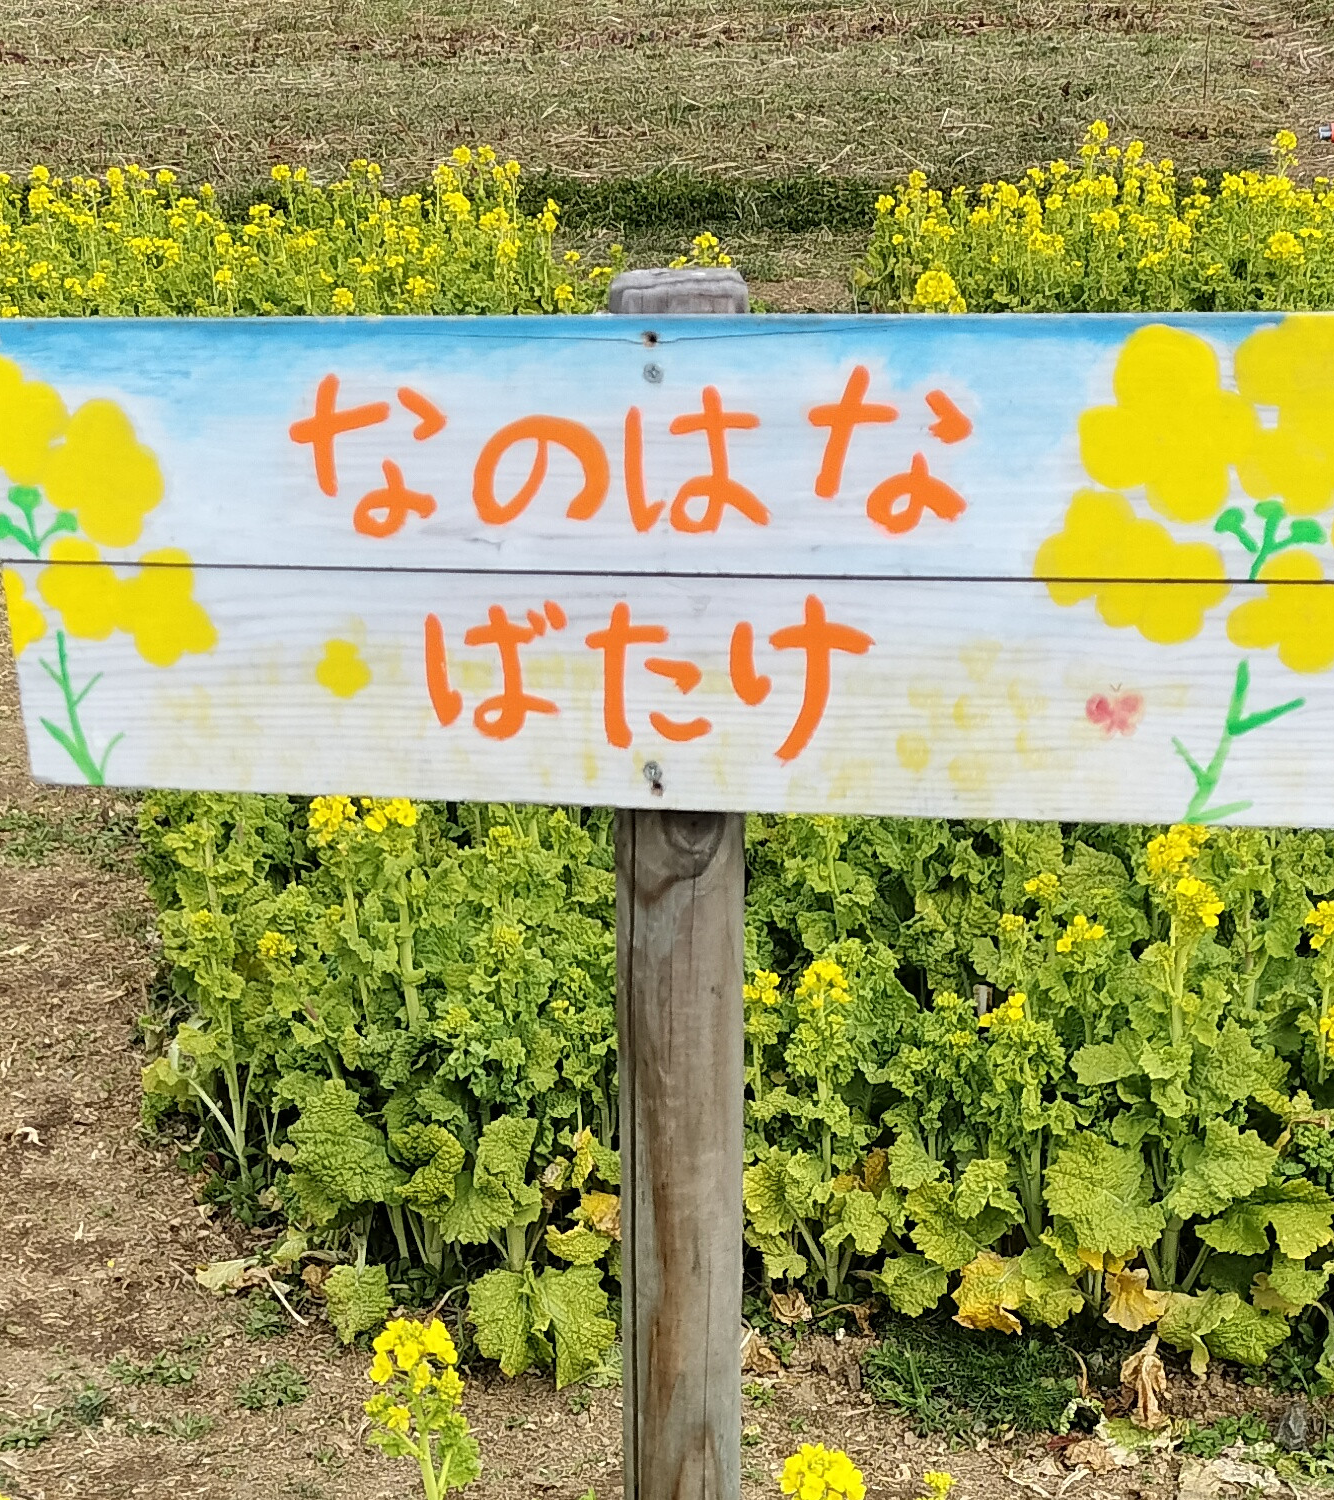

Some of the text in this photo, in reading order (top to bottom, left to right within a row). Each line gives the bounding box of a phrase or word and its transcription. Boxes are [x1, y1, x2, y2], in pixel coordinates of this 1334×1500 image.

[288, 364, 975, 539] なのはな
[423, 593, 877, 763] ばたけ
